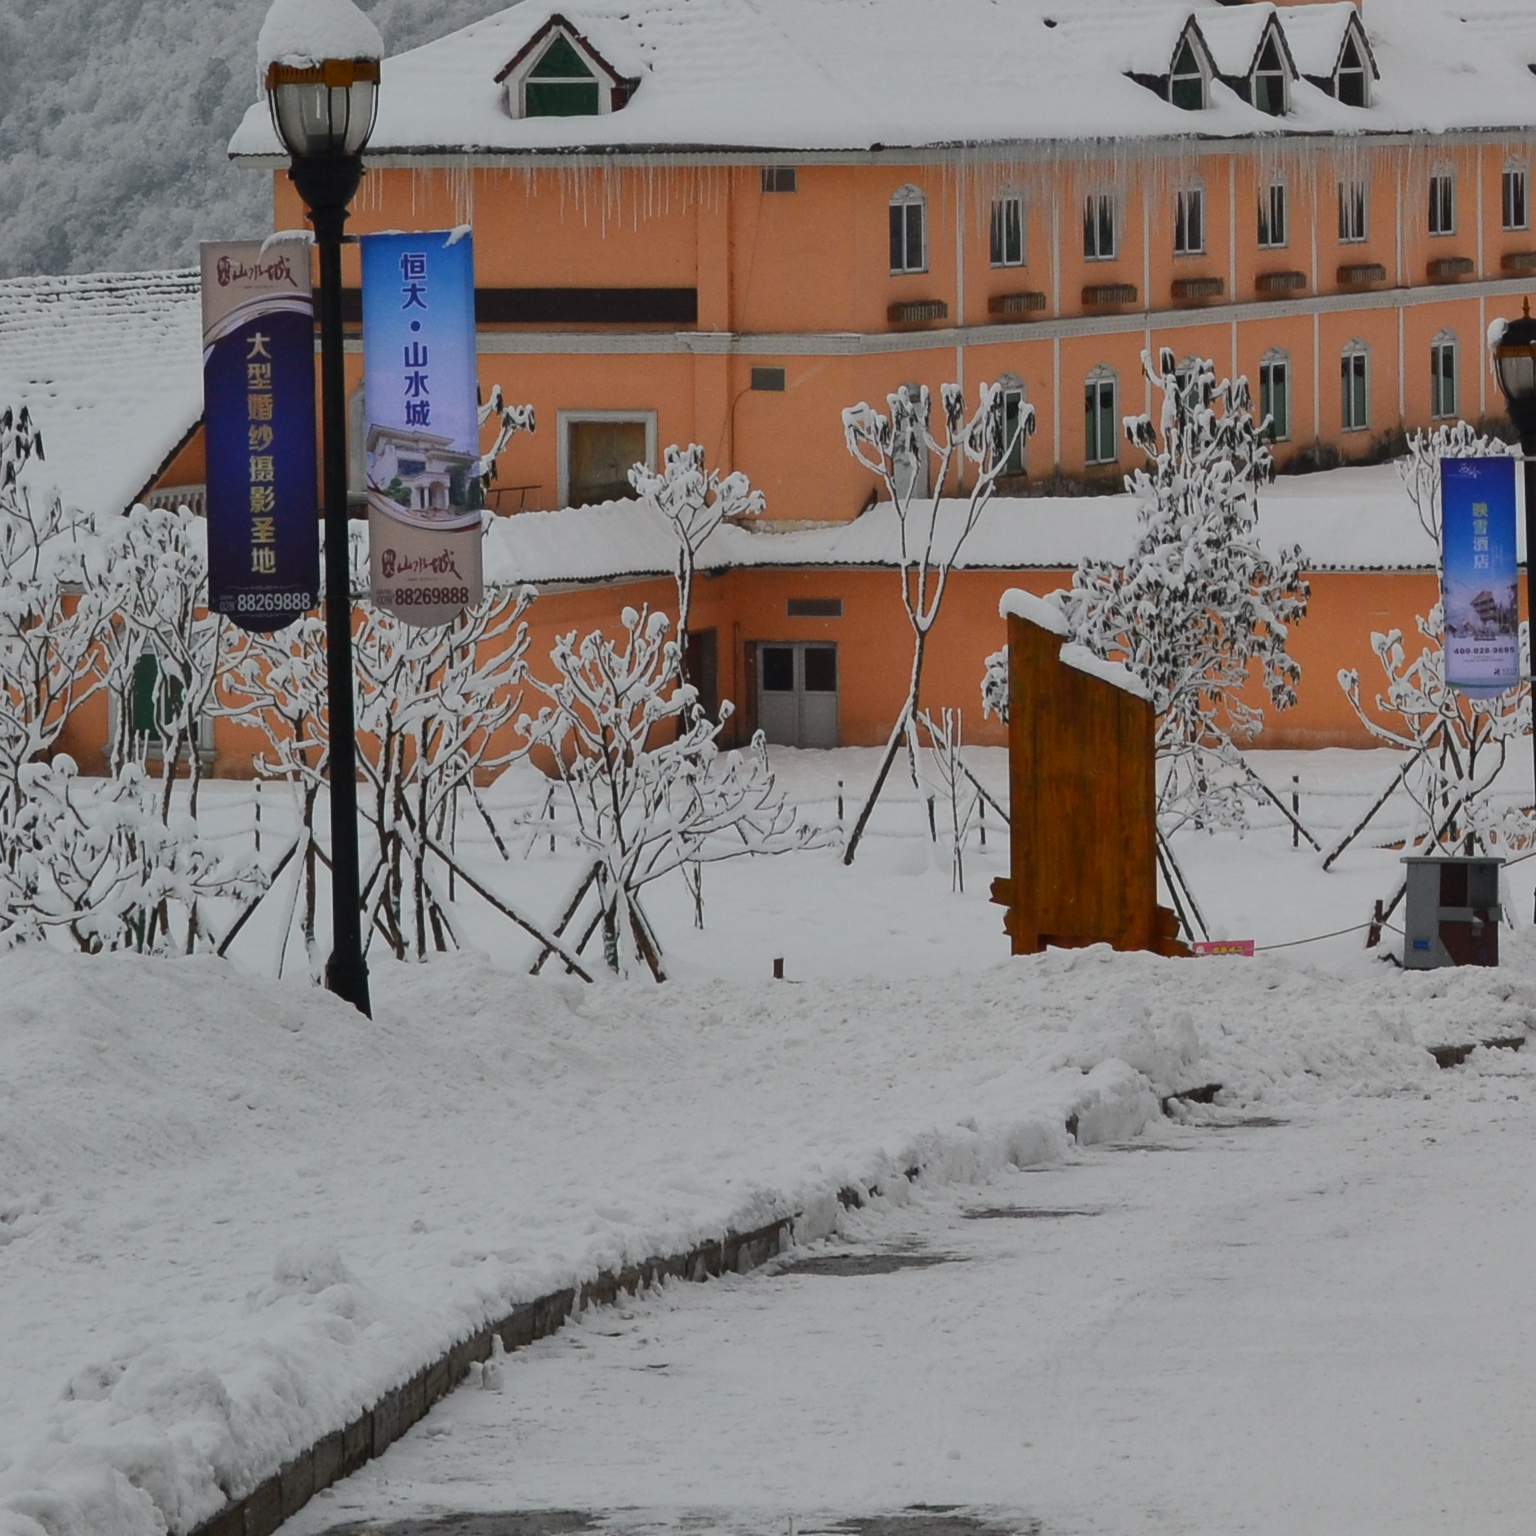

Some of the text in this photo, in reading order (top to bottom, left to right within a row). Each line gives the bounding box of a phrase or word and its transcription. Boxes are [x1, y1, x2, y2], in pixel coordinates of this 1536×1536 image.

[246, 332, 277, 575] 大型婚纱摄影圣地
[1472, 502, 1489, 570] 映雪酒店
[237, 592, 311, 611] 88269888
[395, 587, 469, 605] 88269888
